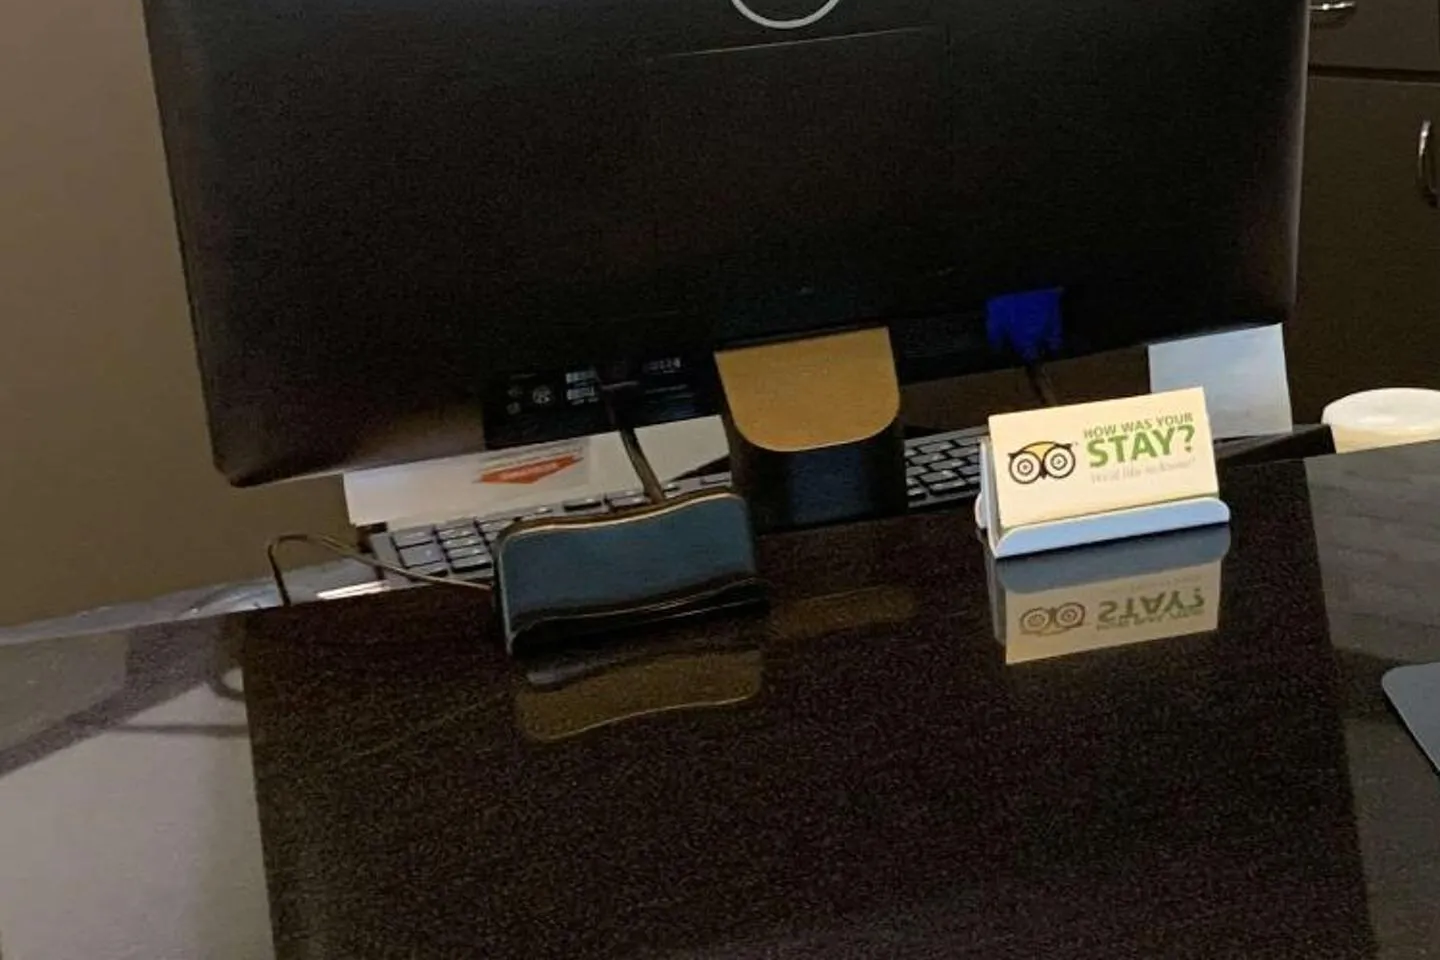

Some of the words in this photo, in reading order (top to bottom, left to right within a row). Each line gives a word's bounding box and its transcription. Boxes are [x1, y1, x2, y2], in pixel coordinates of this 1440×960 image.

[1083, 424, 1117, 439] HOW
[1121, 418, 1153, 433] WAS
[1156, 411, 1194, 427] YOUR
[1087, 424, 1195, 468] STAY?
